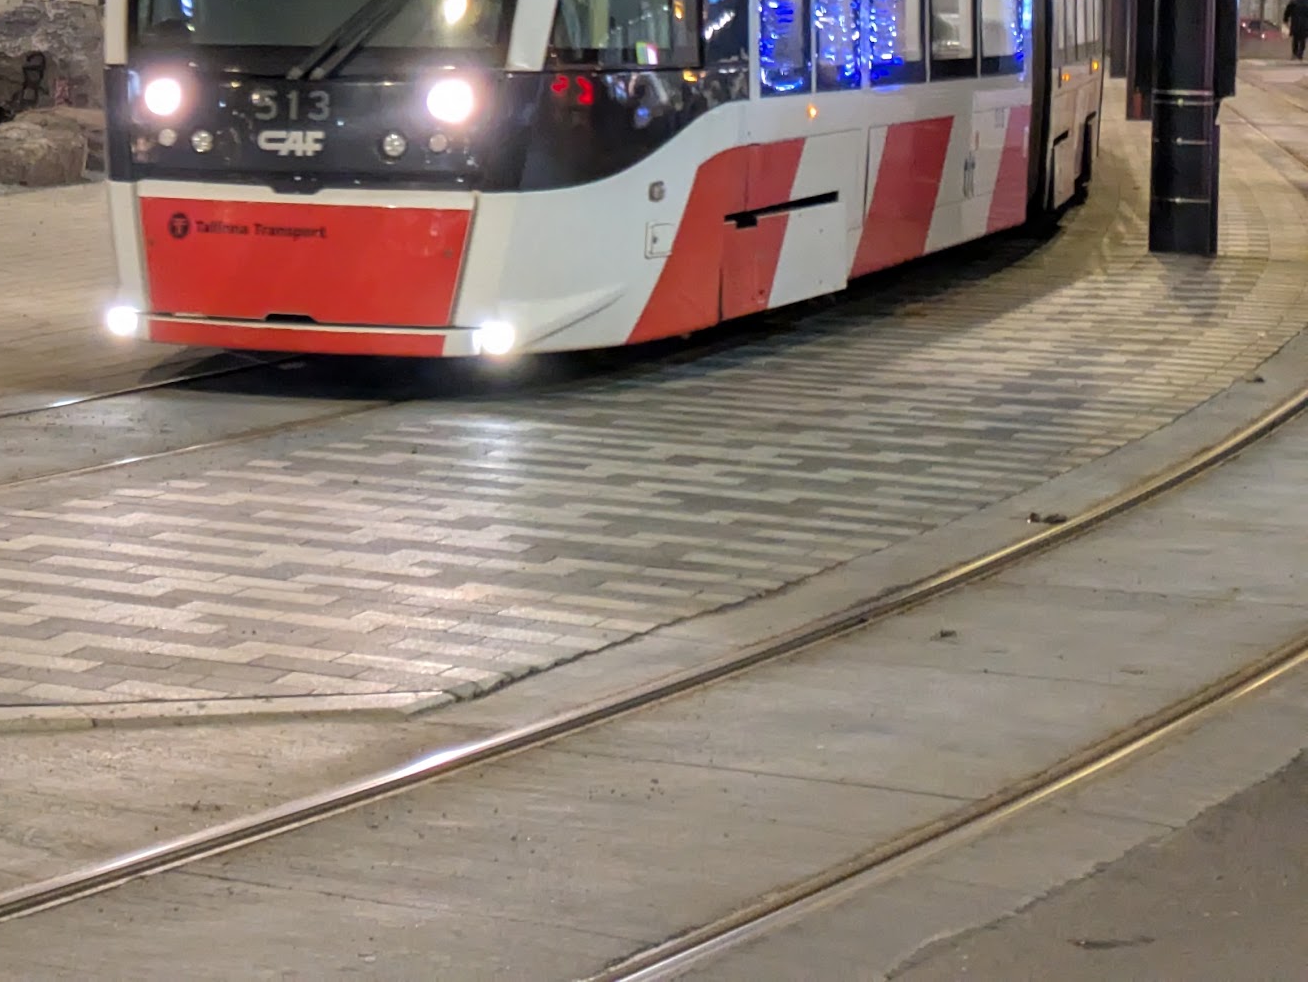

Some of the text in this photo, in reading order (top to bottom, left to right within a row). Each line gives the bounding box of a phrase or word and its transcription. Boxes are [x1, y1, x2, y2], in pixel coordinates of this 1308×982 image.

[253, 90, 330, 120] 513
[257, 130, 325, 156] CAF
[195, 220, 248, 235] Tallinna
[253, 223, 327, 241] Transport
